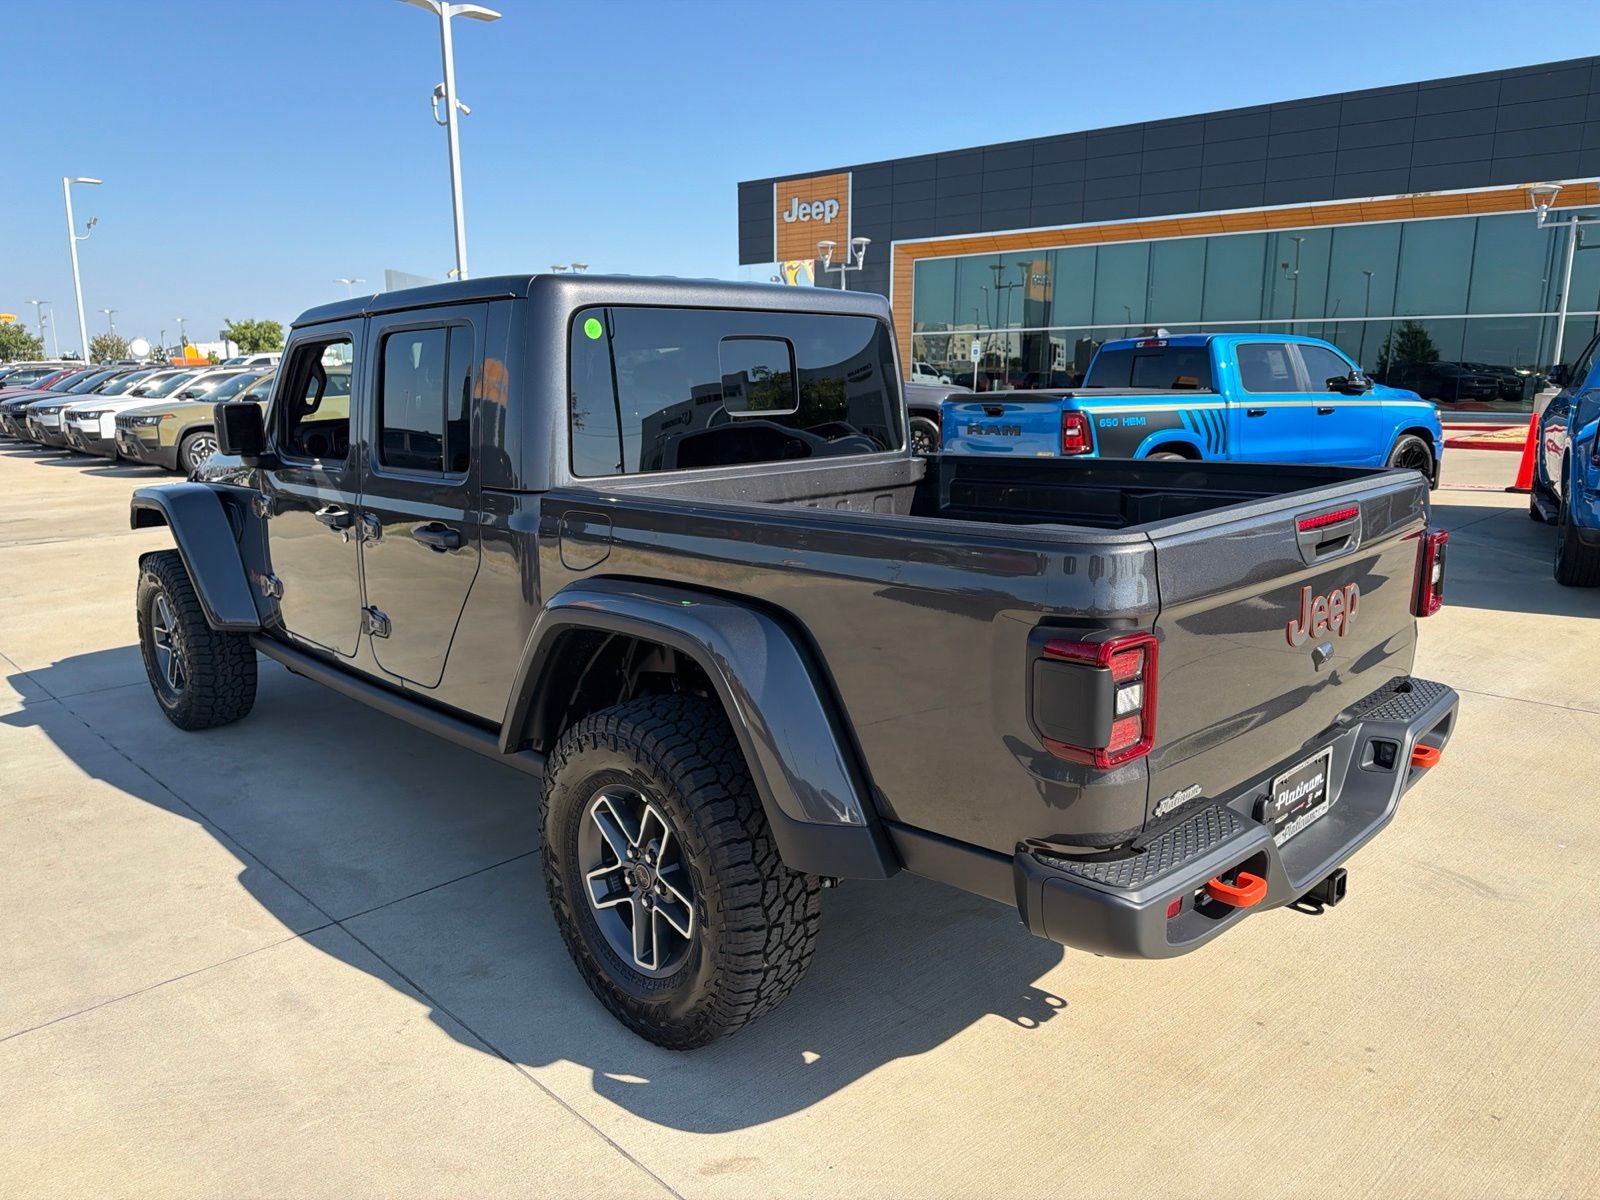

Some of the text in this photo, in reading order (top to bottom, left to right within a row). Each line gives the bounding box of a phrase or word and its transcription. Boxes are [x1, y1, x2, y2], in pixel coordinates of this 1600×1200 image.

[783, 197, 839, 224] Jeep
[967, 424, 1021, 436] RAM
[1122, 416, 1147, 427] HEMI
[1286, 582, 1361, 648] Jeep
[1153, 783, 1202, 817] Platinum
[1275, 773, 1324, 811] Platinum
